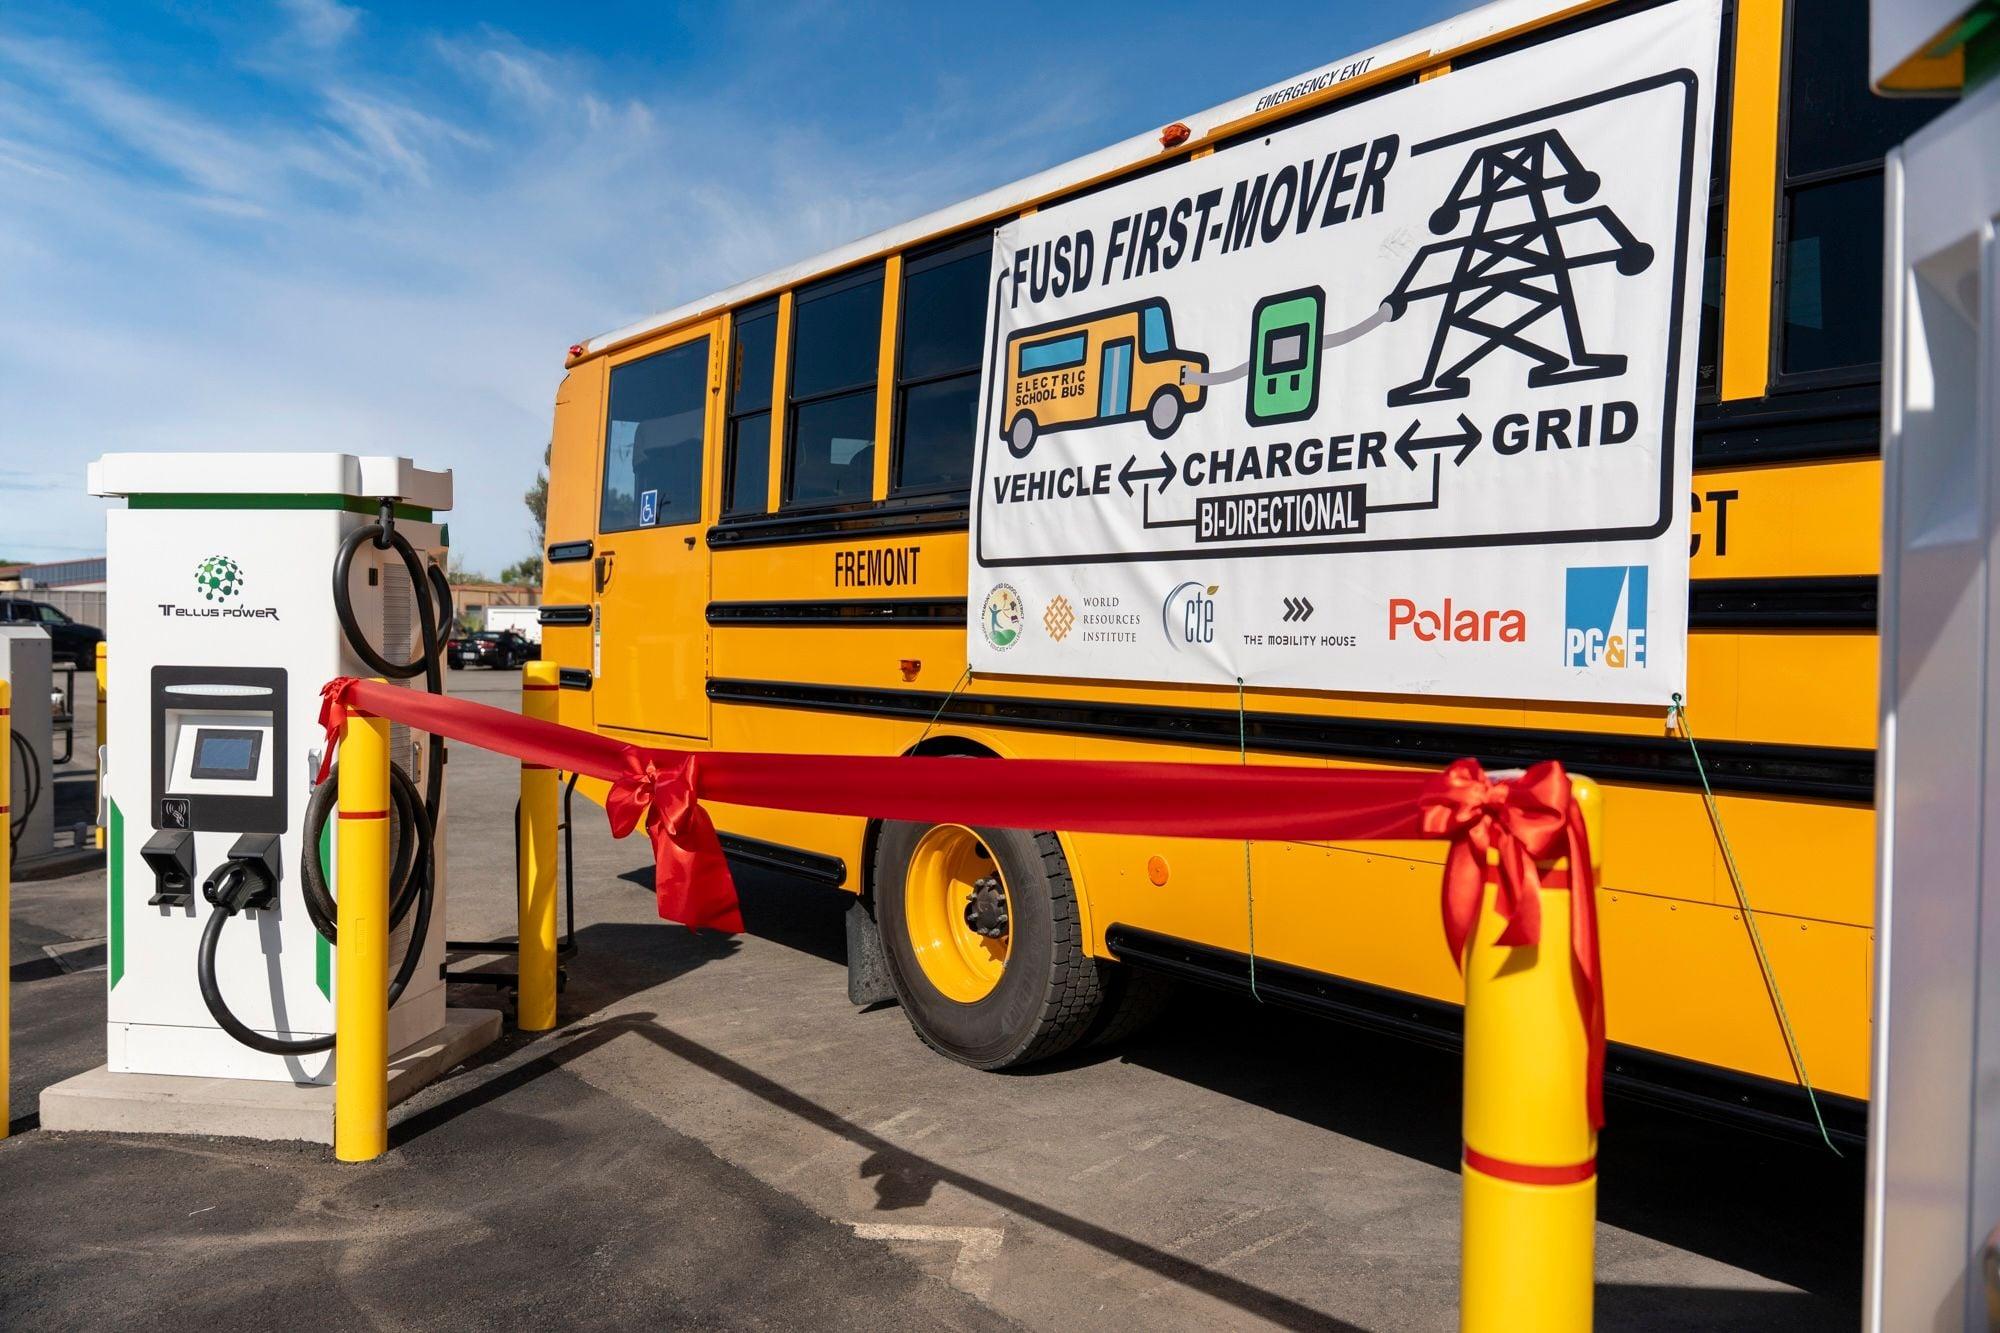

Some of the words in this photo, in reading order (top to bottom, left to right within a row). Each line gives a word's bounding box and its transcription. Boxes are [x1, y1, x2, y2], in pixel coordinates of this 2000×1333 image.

[1254, 69, 1340, 112] EMERGENCY
[1340, 56, 1375, 82] EXIT
[1011, 229, 1095, 308] FUSD
[1102, 133, 1401, 286] FIRST-MOVER
[1015, 389, 1057, 407] SCHOOL
[1061, 384, 1085, 398] BUS
[1016, 370, 1086, 393] ELECTRIC
[1492, 401, 1640, 456] GRID
[1183, 431, 1388, 487] CHARGER
[994, 464, 1112, 504] VEHICLE
[1201, 491, 1359, 538] BI-DIRECTIONAL
[835, 547, 920, 587] FREMONT
[1083, 597, 1119, 607] WORLD
[1083, 614, 1141, 625] RESOURCES
[1185, 592, 1213, 643] cte
[1389, 597, 1526, 643] Polara
[1082, 631, 1137, 642] INSTITUTE
[1243, 635, 1263, 645] THE
[1268, 635, 1316, 646] MOBILITY
[1321, 636, 1356, 646] HOUSE
[1566, 627, 1646, 668] PG&E
